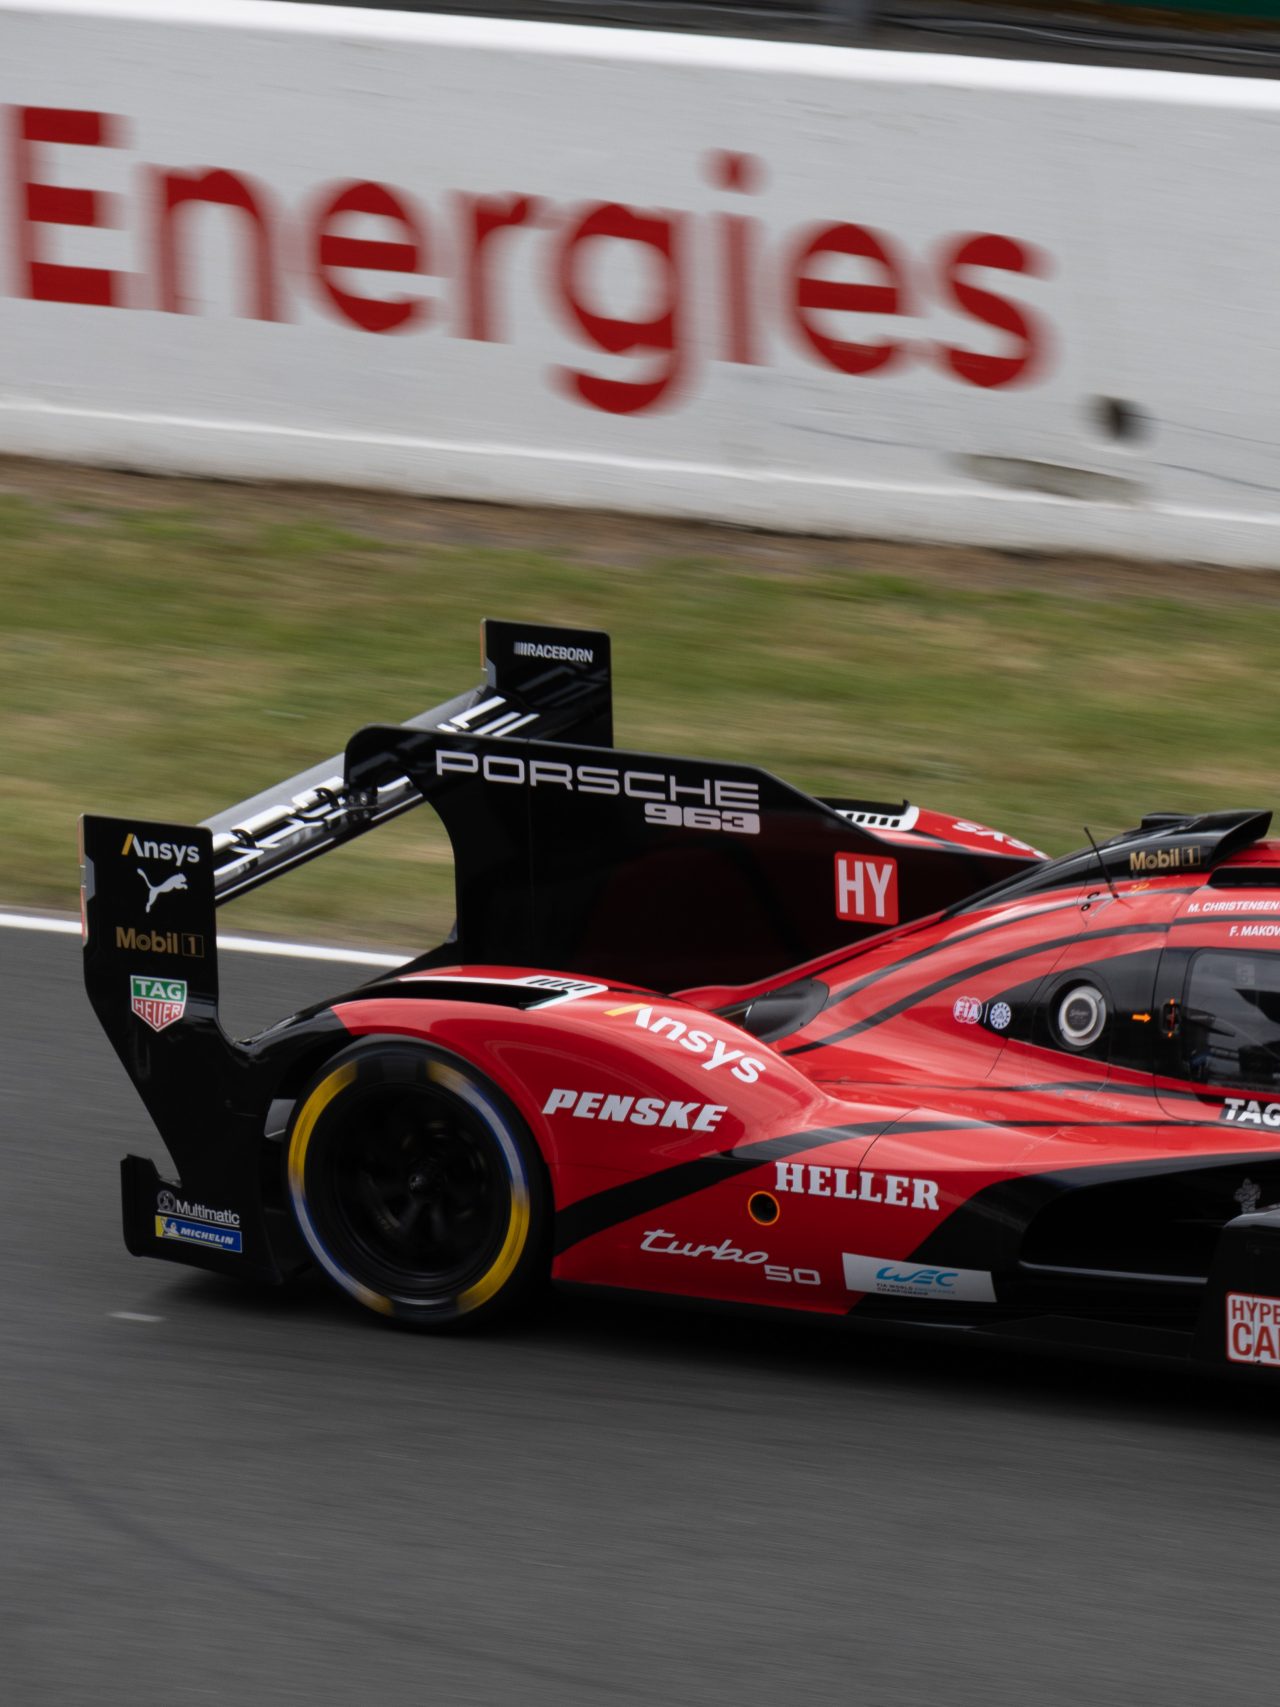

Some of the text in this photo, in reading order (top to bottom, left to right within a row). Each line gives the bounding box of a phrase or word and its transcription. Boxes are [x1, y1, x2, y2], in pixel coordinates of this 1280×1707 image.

[3, 106, 1056, 414] Energies
[527, 643, 594, 663] RACEBORN
[436, 749, 760, 811] PORSCHE
[644, 802, 760, 834] 963
[121, 833, 200, 866] Ansys
[1130, 847, 1198, 871] Mobil 1
[836, 858, 894, 918] HY
[1187, 901, 1280, 913] M. CHRISTENSEN
[116, 927, 201, 956] Mobil 1
[1228, 926, 1239, 937] F.
[135, 979, 182, 1000] TAG
[134, 1000, 182, 1032] HEUER
[603, 1002, 767, 1084] Ansys
[541, 1088, 728, 1133] PENSKE
[774, 1161, 940, 1211] HELLER
[176, 1199, 240, 1225] Multimatic
[180, 1227, 234, 1245] MICHELIN
[640, 1228, 821, 1285] turbo 50
[876, 1266, 960, 1287] WEC
